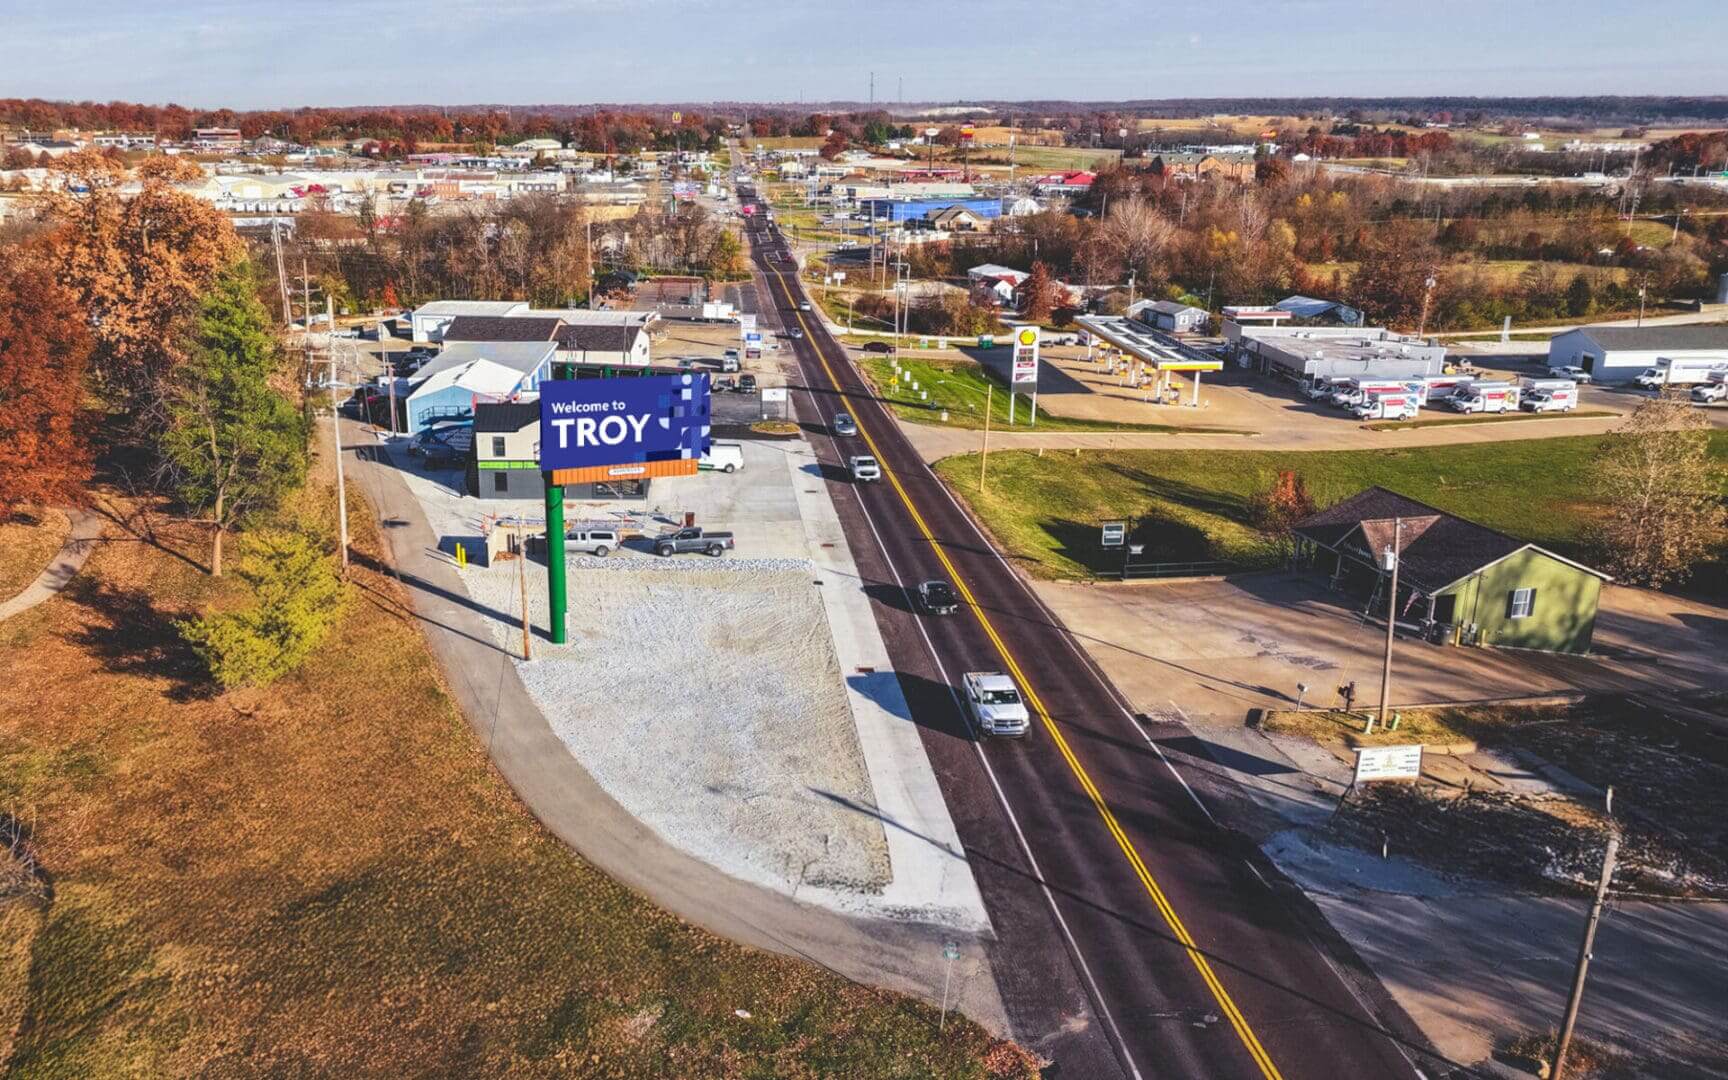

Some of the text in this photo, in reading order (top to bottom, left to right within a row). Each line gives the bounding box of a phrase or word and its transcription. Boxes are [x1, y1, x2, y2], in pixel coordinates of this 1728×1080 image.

[551, 400, 626, 414] Welcome to
[551, 413, 651, 449] TROY
